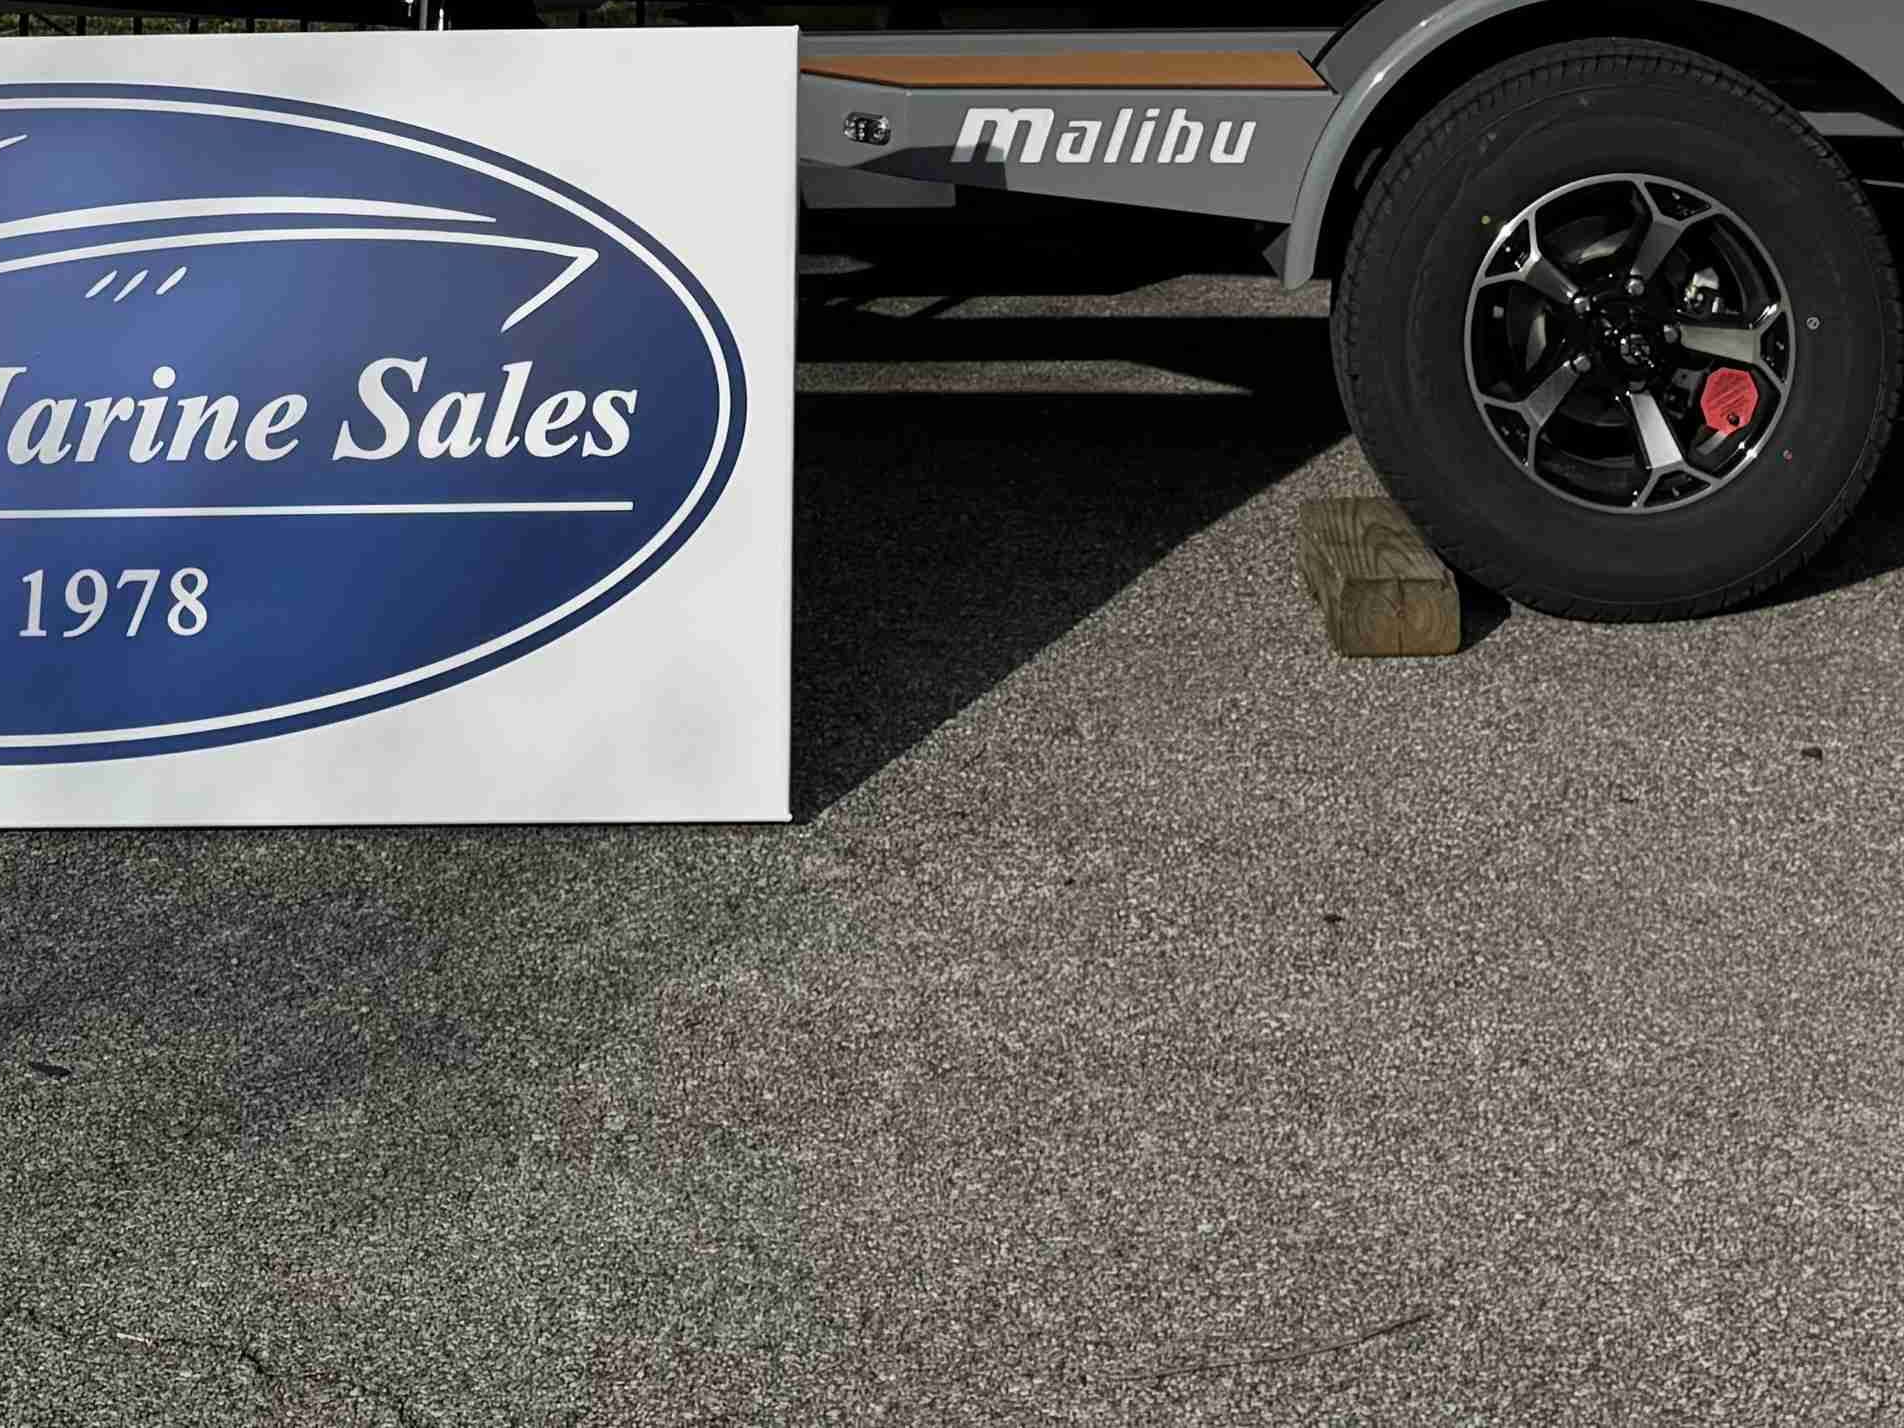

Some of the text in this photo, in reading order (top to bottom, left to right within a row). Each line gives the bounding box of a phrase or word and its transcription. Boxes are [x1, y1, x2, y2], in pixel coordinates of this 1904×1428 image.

[949, 107, 1257, 165] Malibu
[330, 355, 639, 462] Sales
[18, 566, 210, 638] 1978
